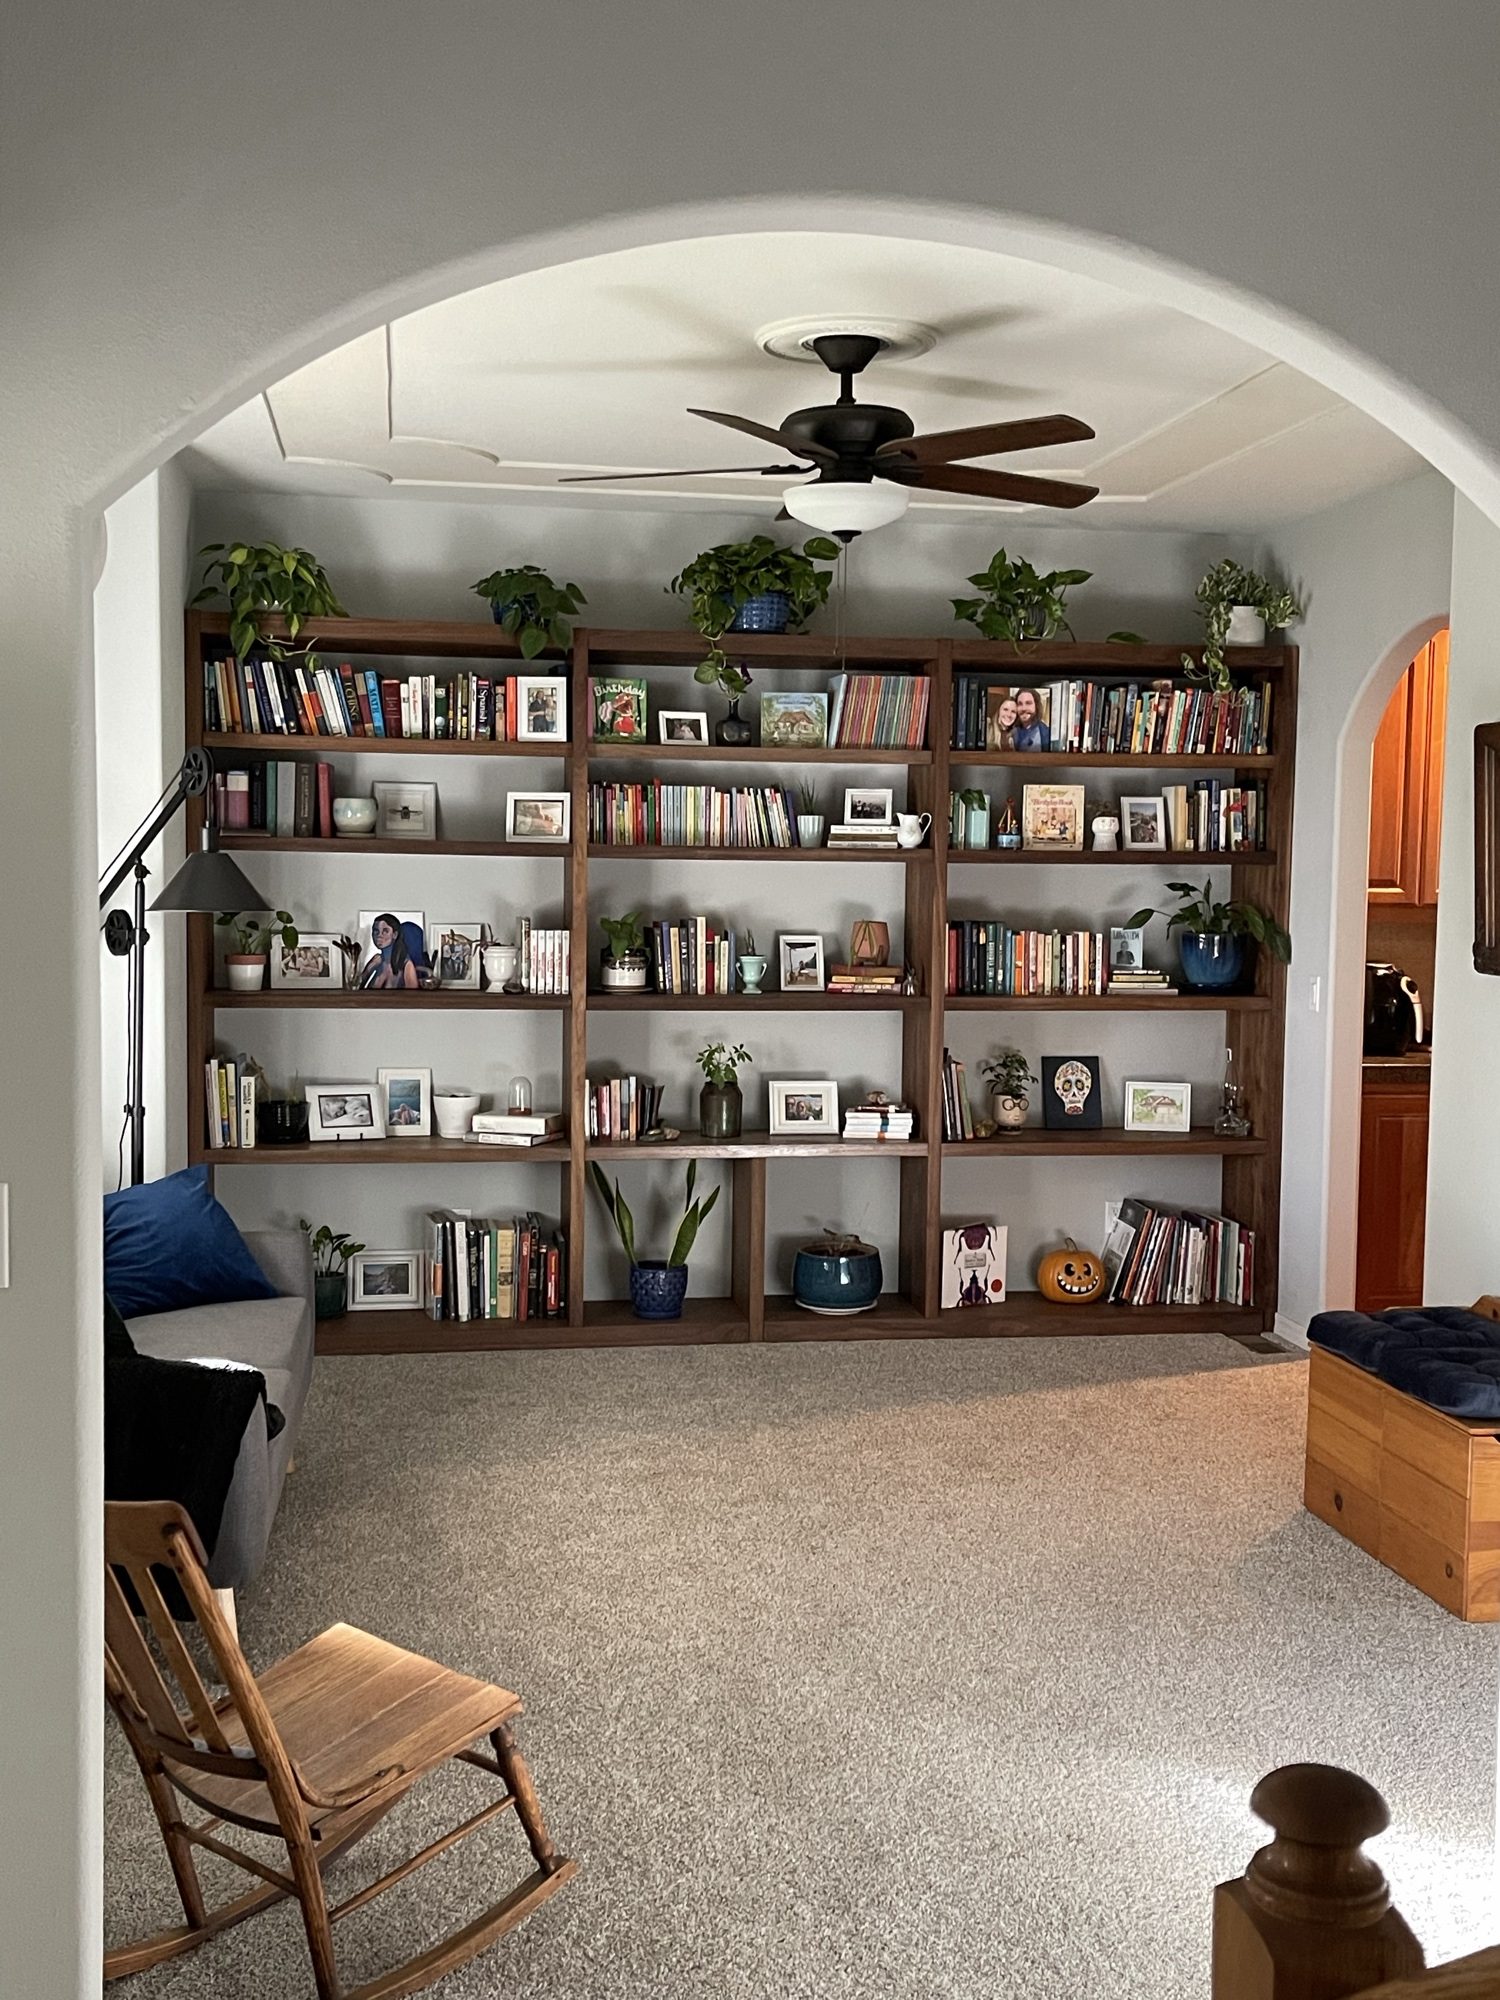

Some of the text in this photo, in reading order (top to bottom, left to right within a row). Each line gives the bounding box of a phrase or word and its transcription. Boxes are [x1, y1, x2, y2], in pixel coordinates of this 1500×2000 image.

[345, 688, 360, 721] CHING
[478, 689, 488, 723] Spanish
[593, 684, 646, 700] Birthday
